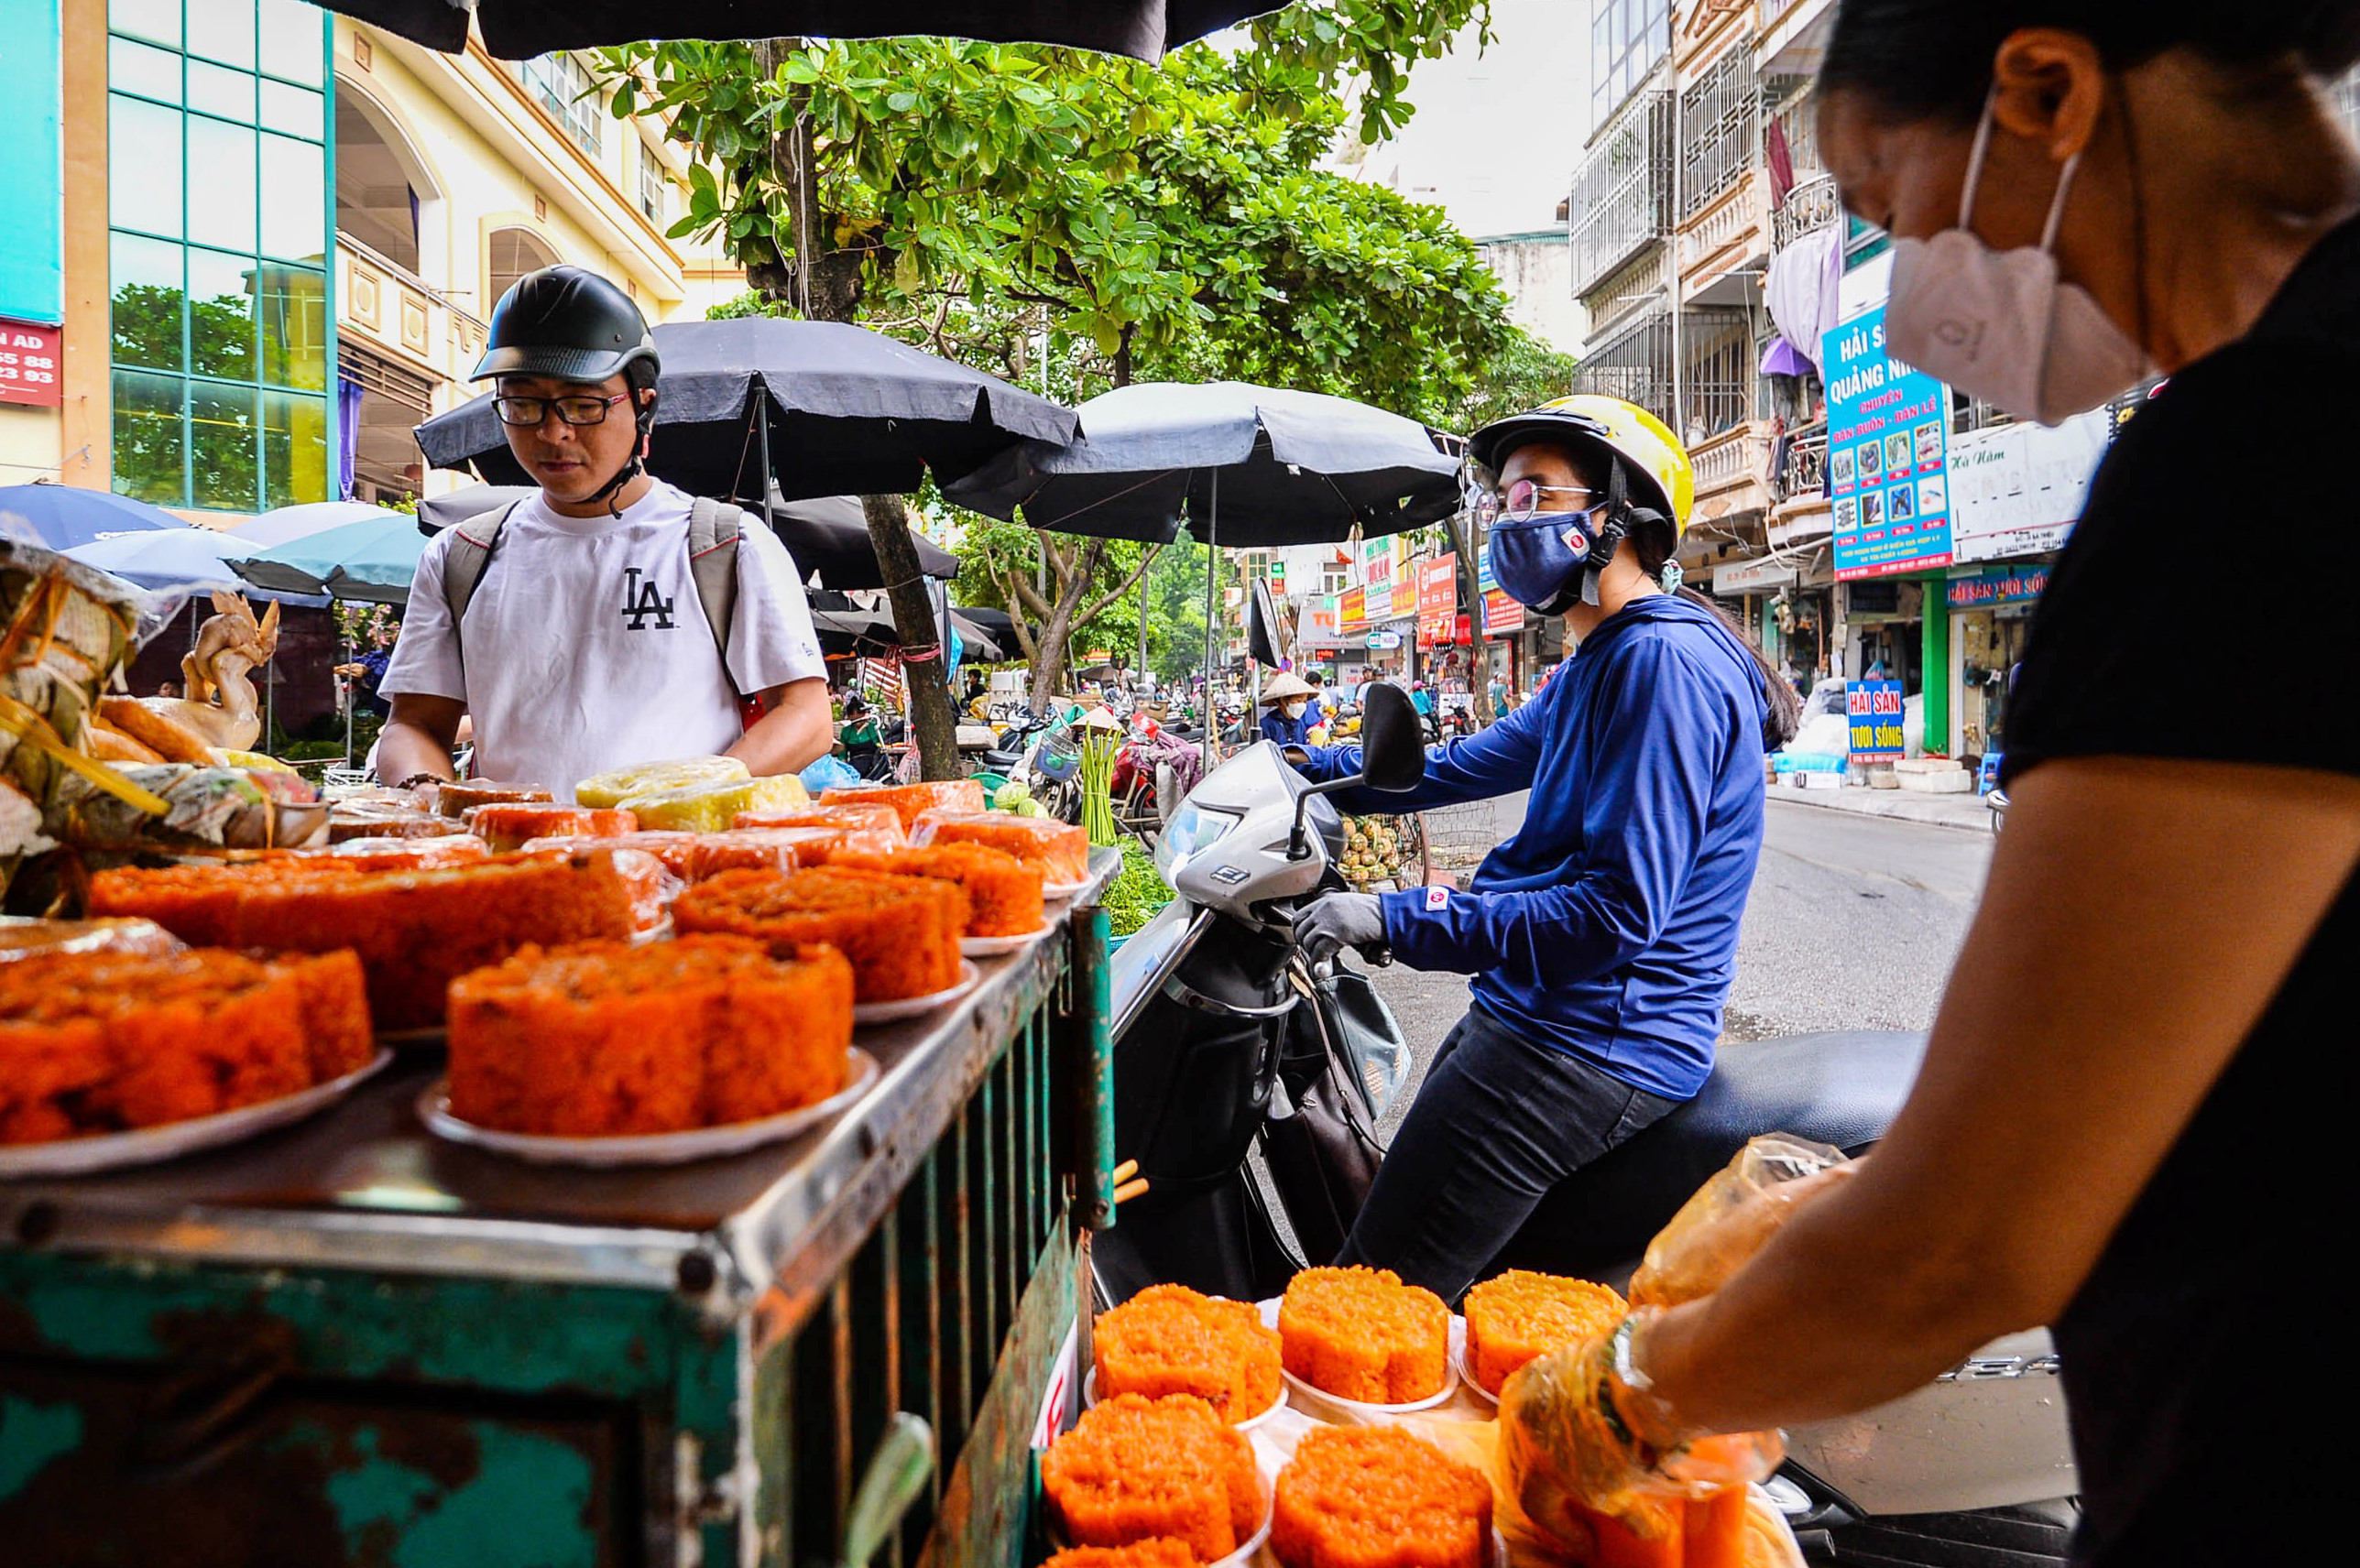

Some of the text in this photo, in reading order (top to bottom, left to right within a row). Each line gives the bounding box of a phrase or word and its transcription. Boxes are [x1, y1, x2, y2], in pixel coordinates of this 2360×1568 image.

[13, 334, 43, 349] AD
[1840, 323, 1887, 363] HẢI S
[24, 355, 54, 369] 88
[24, 369, 54, 384] 93
[1830, 365, 1885, 405] QUẢNG
[1859, 388, 1903, 414] CHUYÊN
[1856, 416, 1885, 436] BUÔN
[1895, 405, 1918, 423] BÁN
[621, 567, 675, 631] LA
[1849, 683, 1901, 715] HẢI SẢN
[1851, 719, 1903, 748] TƯƠI SỐNG
